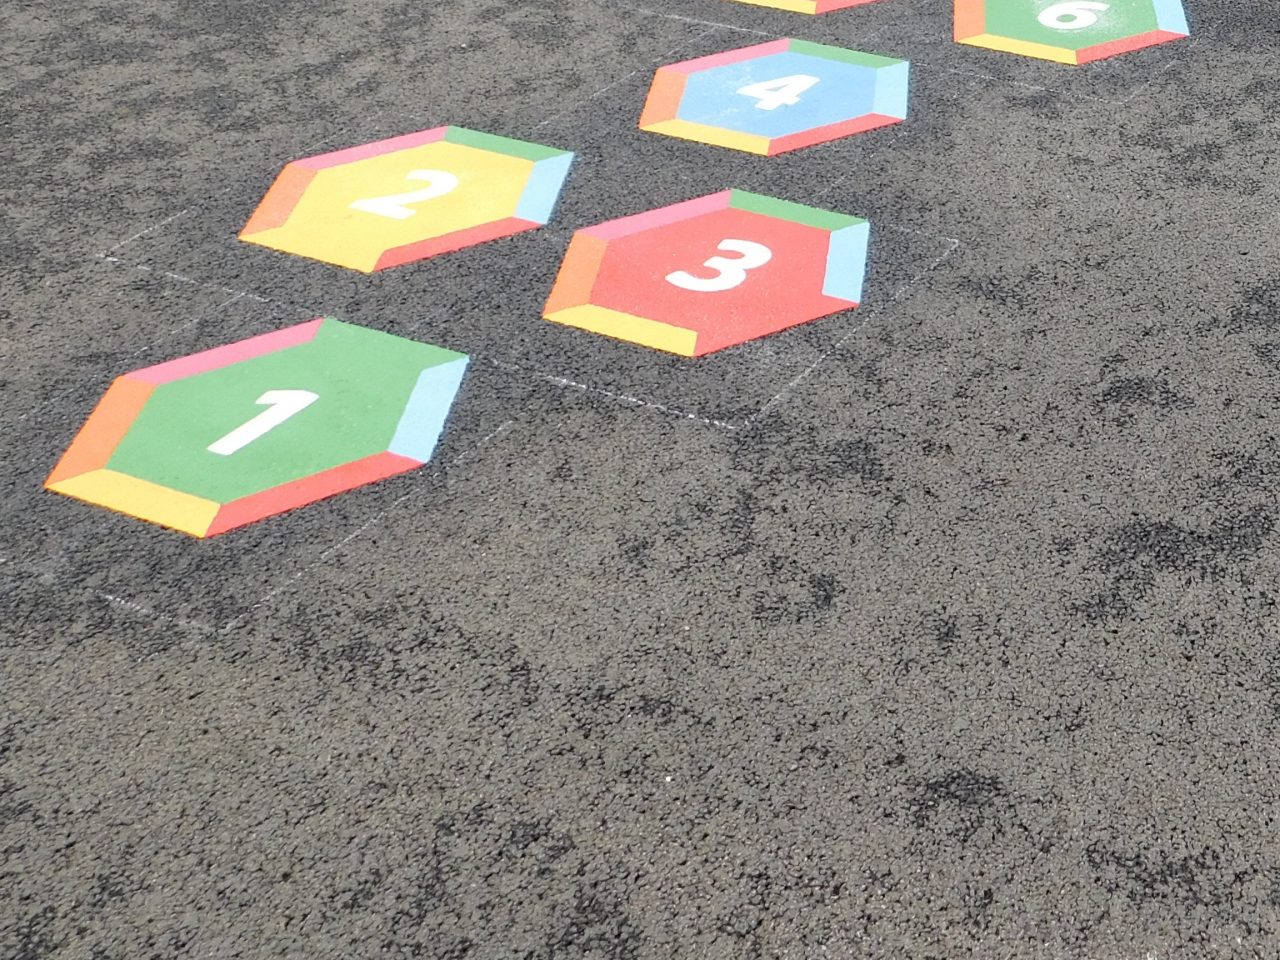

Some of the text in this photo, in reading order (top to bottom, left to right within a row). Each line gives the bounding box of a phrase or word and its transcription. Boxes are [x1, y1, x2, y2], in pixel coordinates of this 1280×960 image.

[1036, 0, 1110, 30] 6
[735, 74, 820, 111] 4
[350, 169, 460, 220] 2
[665, 238, 774, 292] 3
[206, 389, 320, 456] 1
